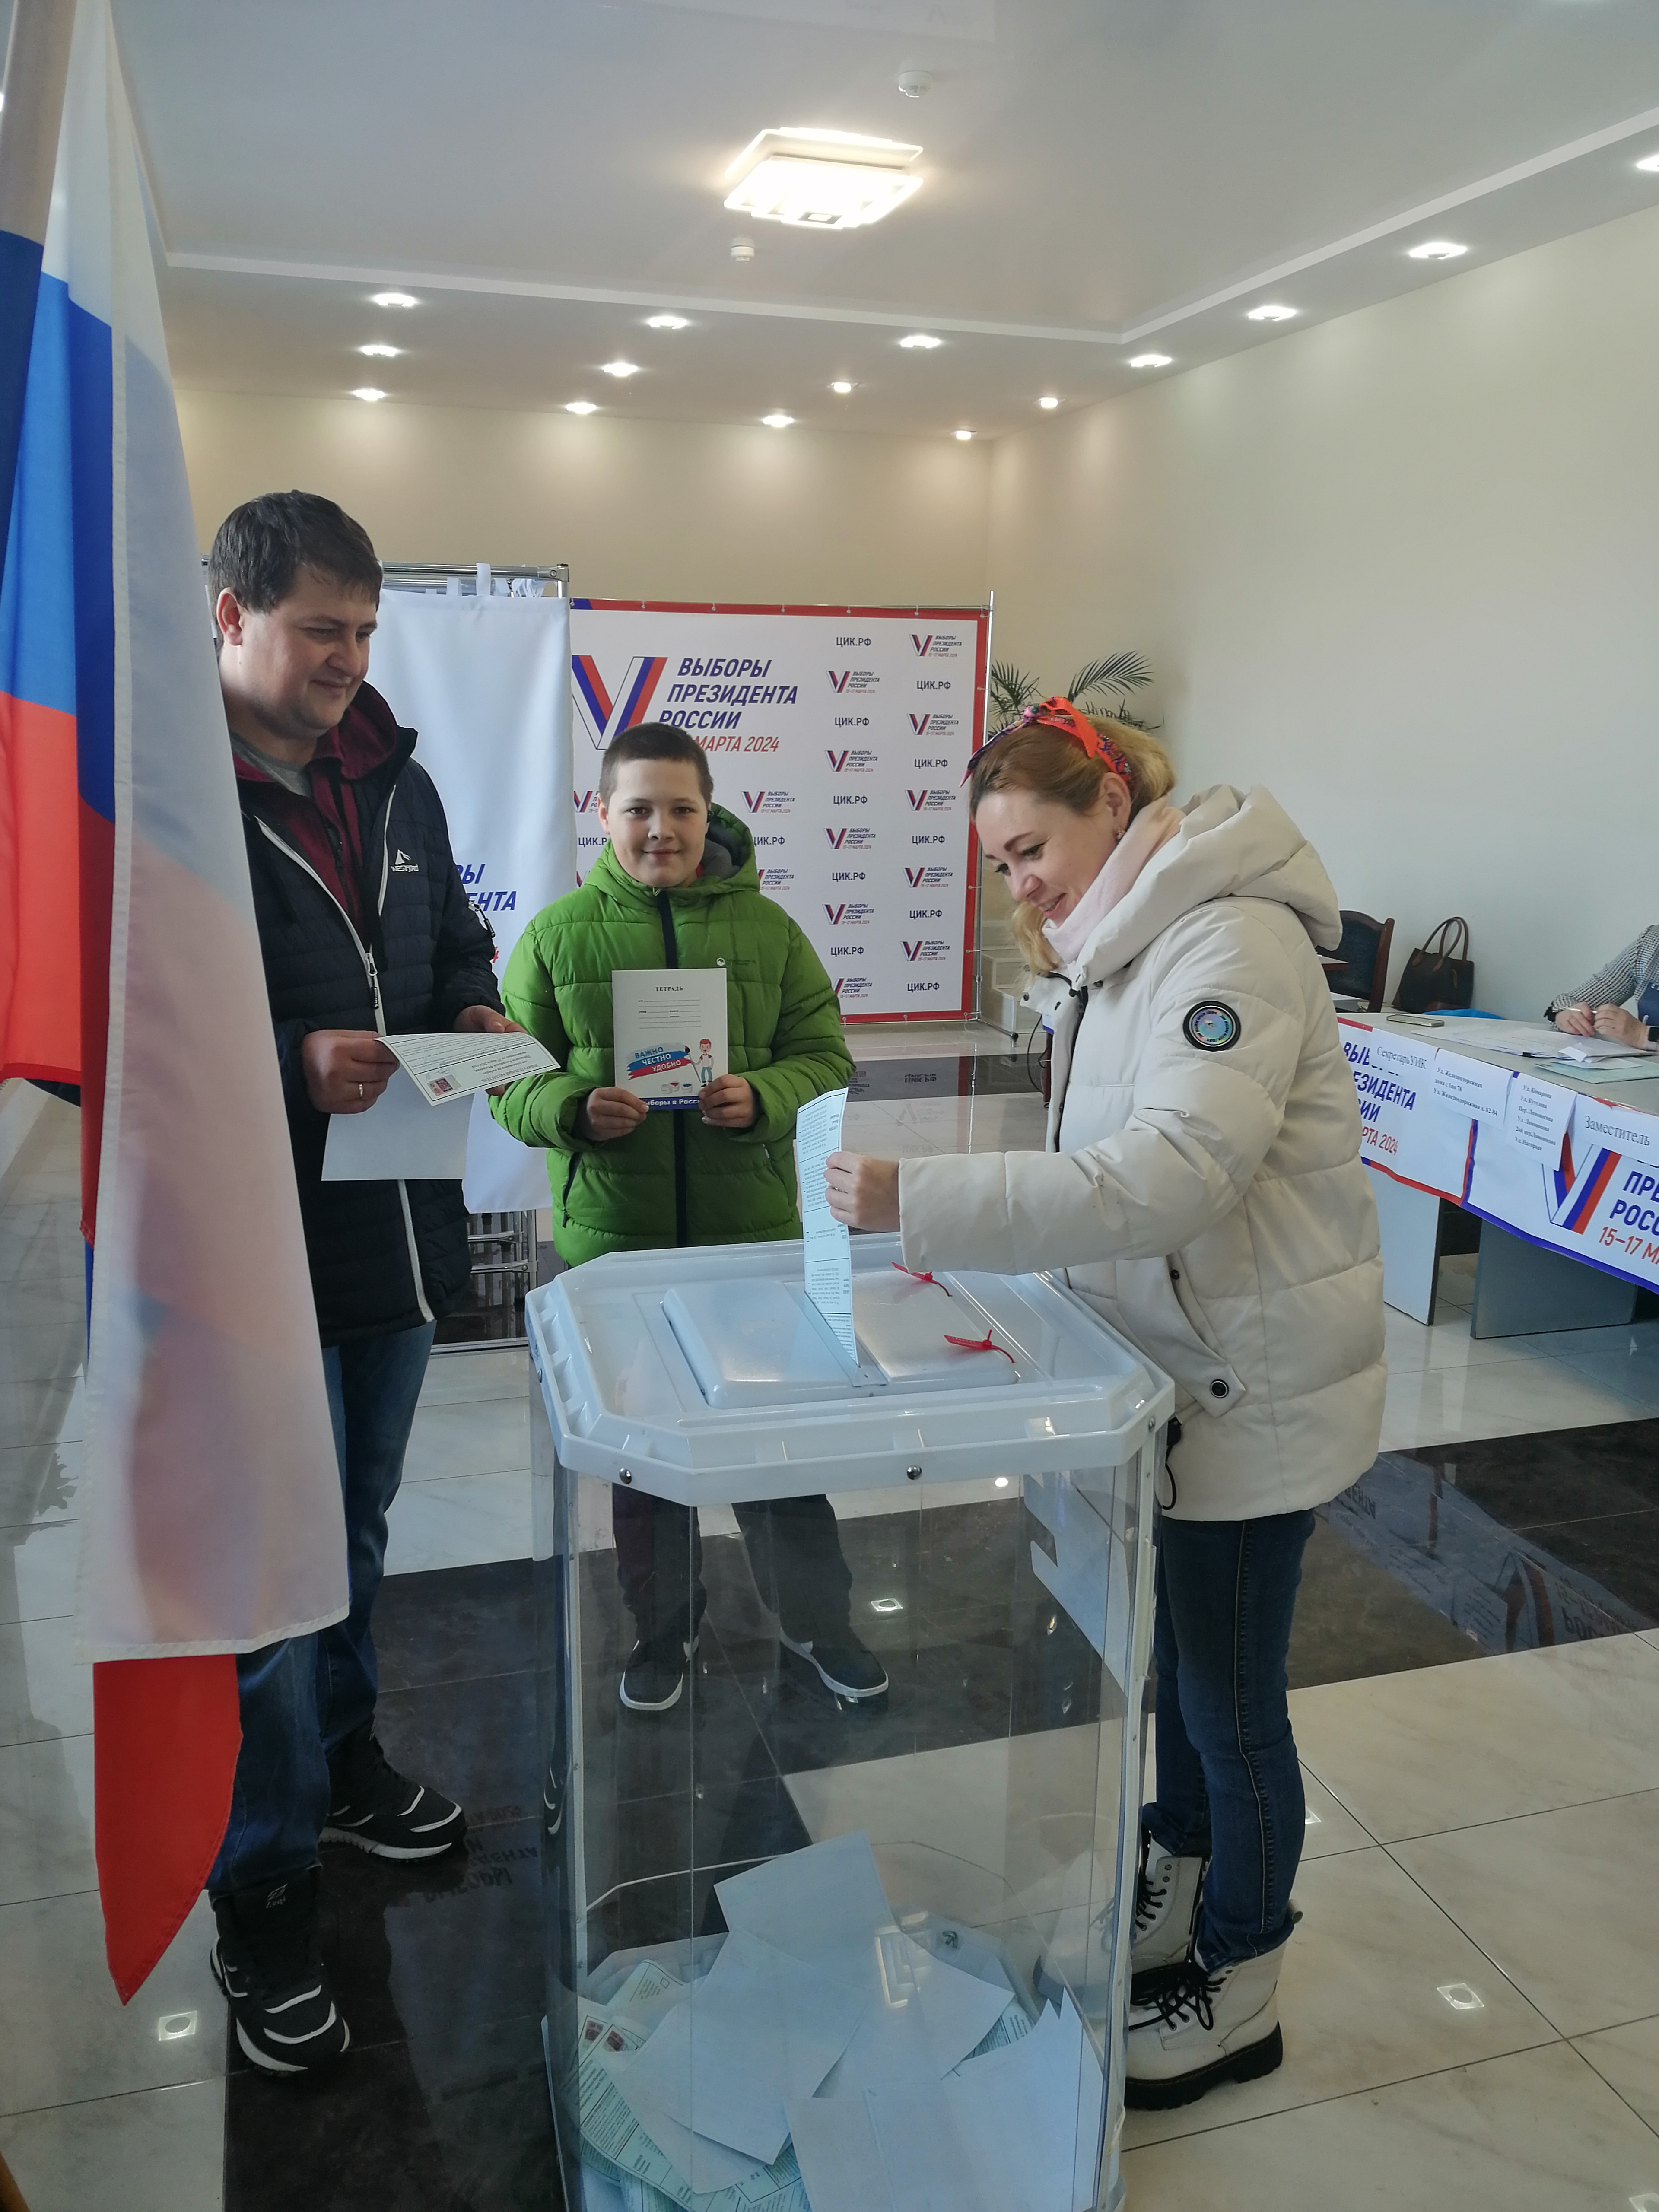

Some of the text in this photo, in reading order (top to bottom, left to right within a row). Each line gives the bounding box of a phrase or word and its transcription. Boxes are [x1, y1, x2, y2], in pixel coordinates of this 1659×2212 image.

[836, 637, 871, 648] ЦИК.РФ
[677, 658, 772, 677] ВЫБОРЫ
[917, 680, 951, 691] ЦИК.РФ
[667, 684, 798, 706] ПРЕЗИДЕНТА
[658, 710, 742, 729] РОССИИ
[835, 717, 870, 728] ЦИК.РФ
[744, 736, 779, 753] 2024
[915, 759, 948, 769] ЦИК.РФ
[833, 795, 868, 806] ЦИК.РФ
[578, 837, 607, 847] ЦИК.Р
[912, 835, 945, 845] ЦИК.РФ
[832, 872, 866, 882] ЦИК.РФ
[909, 909, 942, 920] ЦИК.РФ
[830, 946, 864, 957] ЦИК.РФ
[907, 982, 940, 993] ЦИК.РФ
[635, 1047, 664, 1058] ВАЖНО
[642, 1054, 671, 1065] ЧЕСТНО
[652, 1060, 681, 1072] УДОБНО
[1445, 1070, 1482, 1088] Железнодорожная
[1354, 1071, 1416, 1110] ЕЗИДЕНТА
[1441, 1091, 1480, 1109] Железнодорожная
[1585, 1115, 1650, 1146] Заместитель
[1362, 1126, 1398, 1156] РТА 2024
